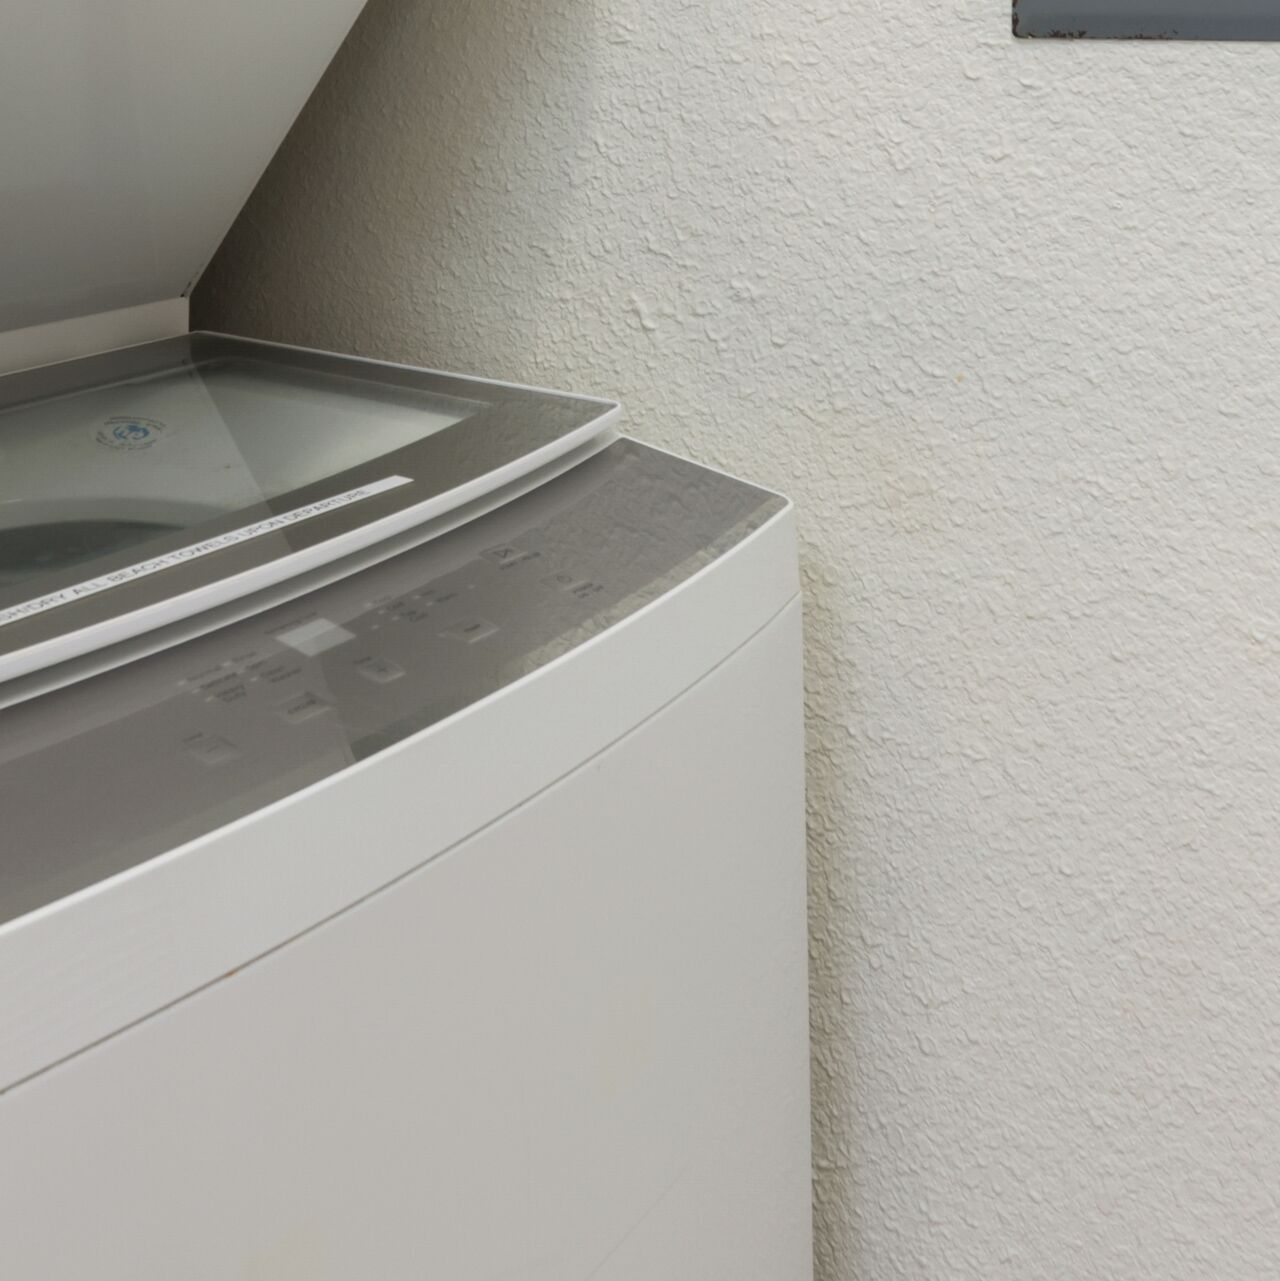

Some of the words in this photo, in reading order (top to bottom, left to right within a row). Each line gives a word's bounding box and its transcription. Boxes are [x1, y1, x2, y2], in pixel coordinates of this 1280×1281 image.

[71, 580, 108, 597] ALL
[106, 558, 170, 583] BEACH
[170, 534, 239, 561] TOWELS
[238, 519, 284, 537] UPON
[283, 489, 371, 521] DEPARTURE
